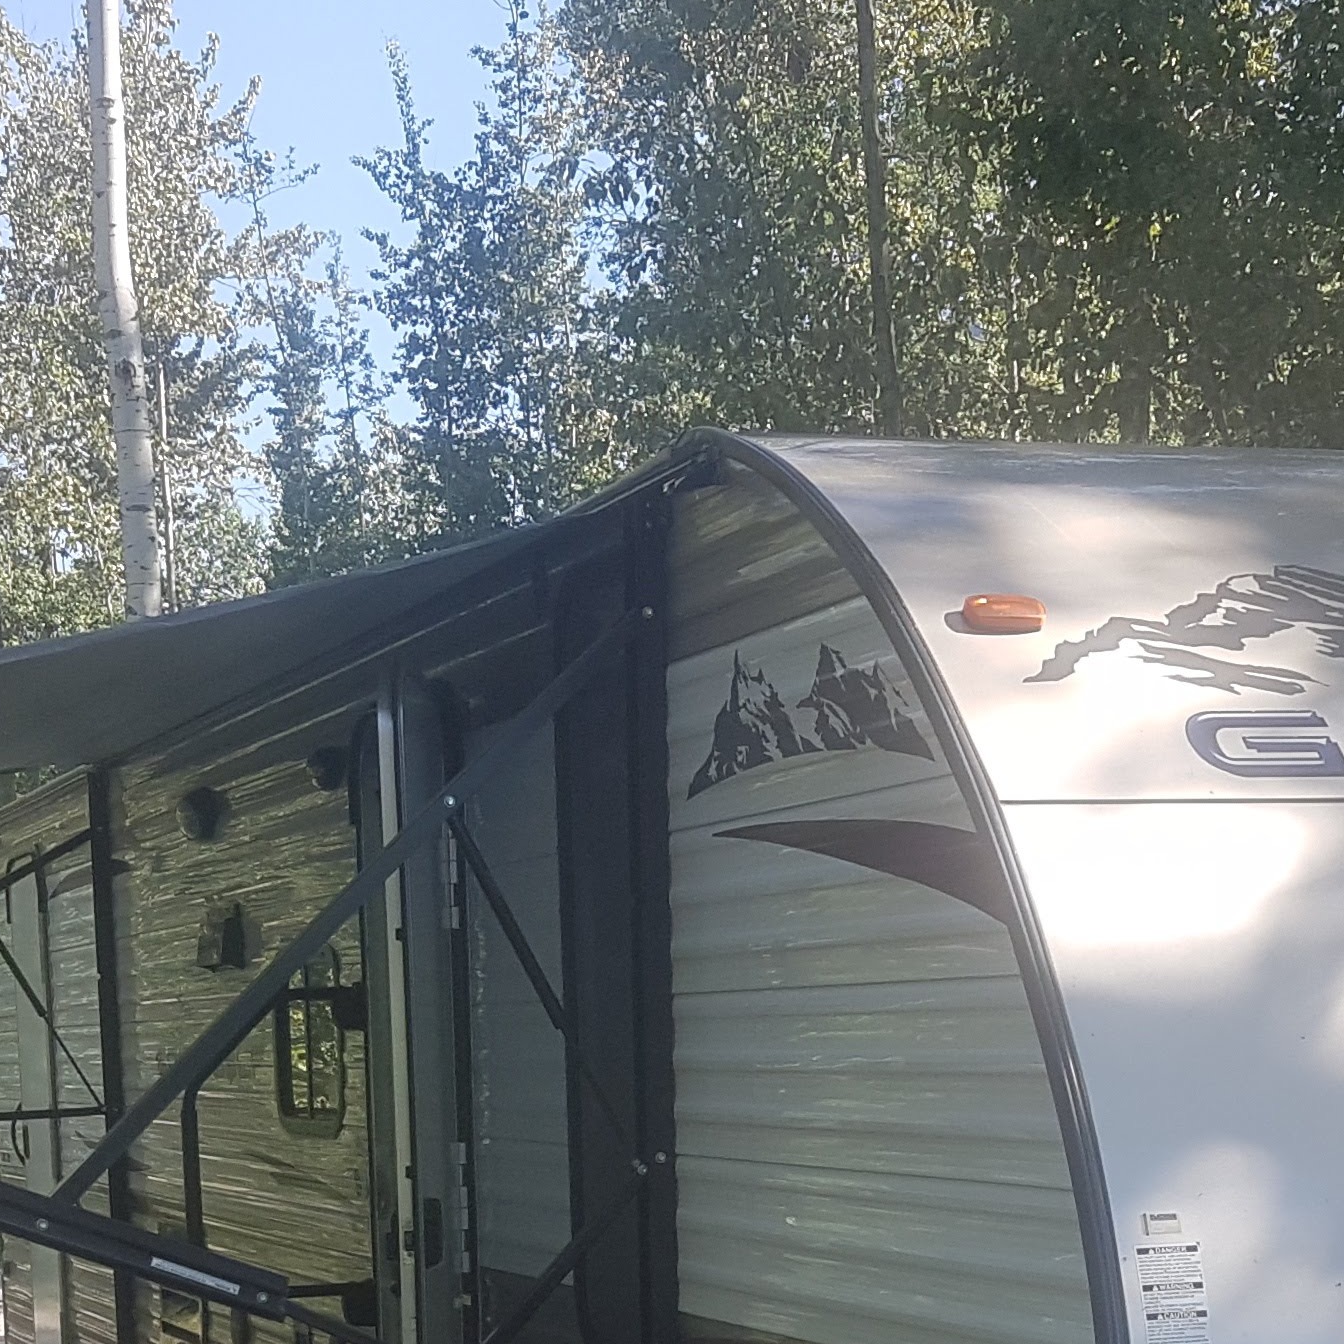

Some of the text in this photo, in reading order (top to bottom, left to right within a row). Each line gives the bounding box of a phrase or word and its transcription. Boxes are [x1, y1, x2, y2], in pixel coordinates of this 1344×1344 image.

[1156, 1246, 1186, 1254] DANGER
[1159, 1283, 1194, 1291] WARNING
[1164, 1311, 1197, 1320] CAUTION
